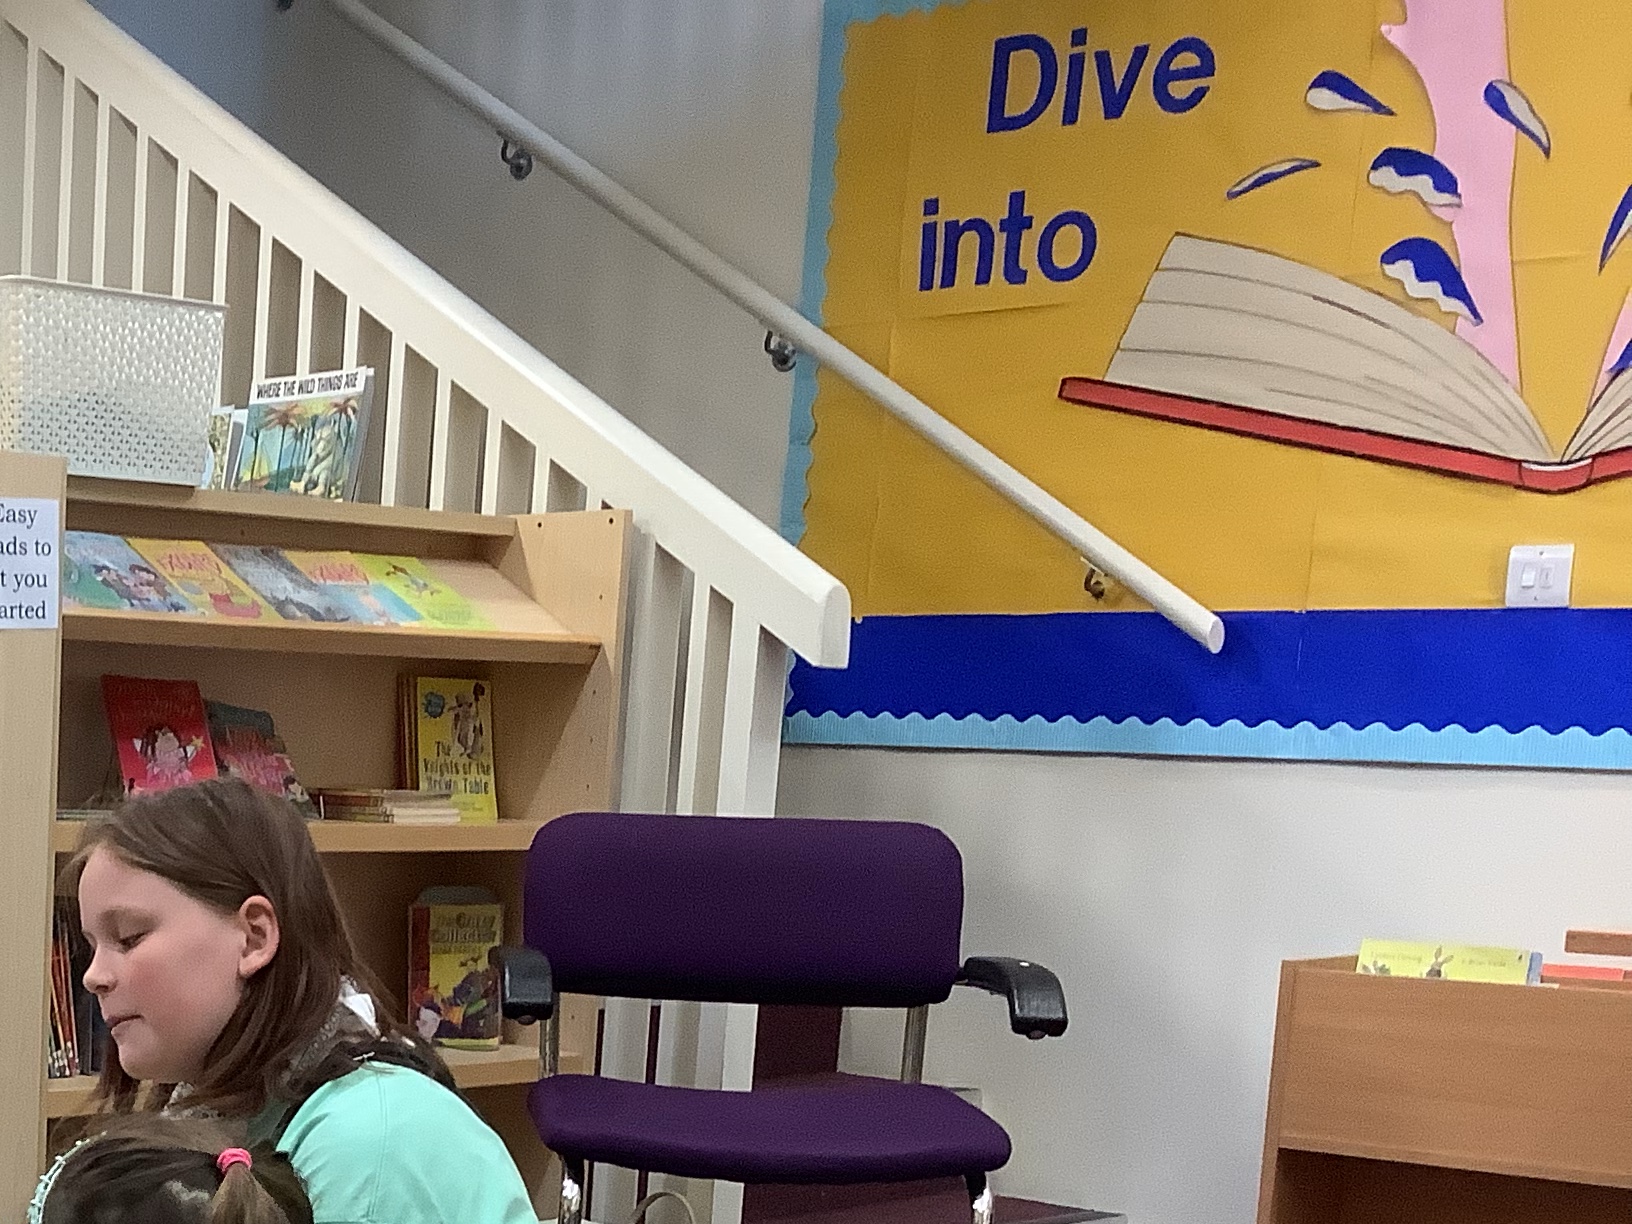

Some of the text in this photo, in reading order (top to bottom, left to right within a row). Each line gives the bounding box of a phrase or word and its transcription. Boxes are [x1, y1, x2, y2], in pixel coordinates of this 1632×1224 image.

[986, 28, 1217, 133] Dive
[919, 191, 1097, 292] into
[256, 371, 359, 399] WHERE THE WILD THINGS ARE
[34, 538, 52, 556] to
[12, 575, 48, 594] you
[435, 741, 452, 757] The
[462, 762, 473, 775] of
[476, 761, 491, 776] the
[464, 777, 489, 795] Table
